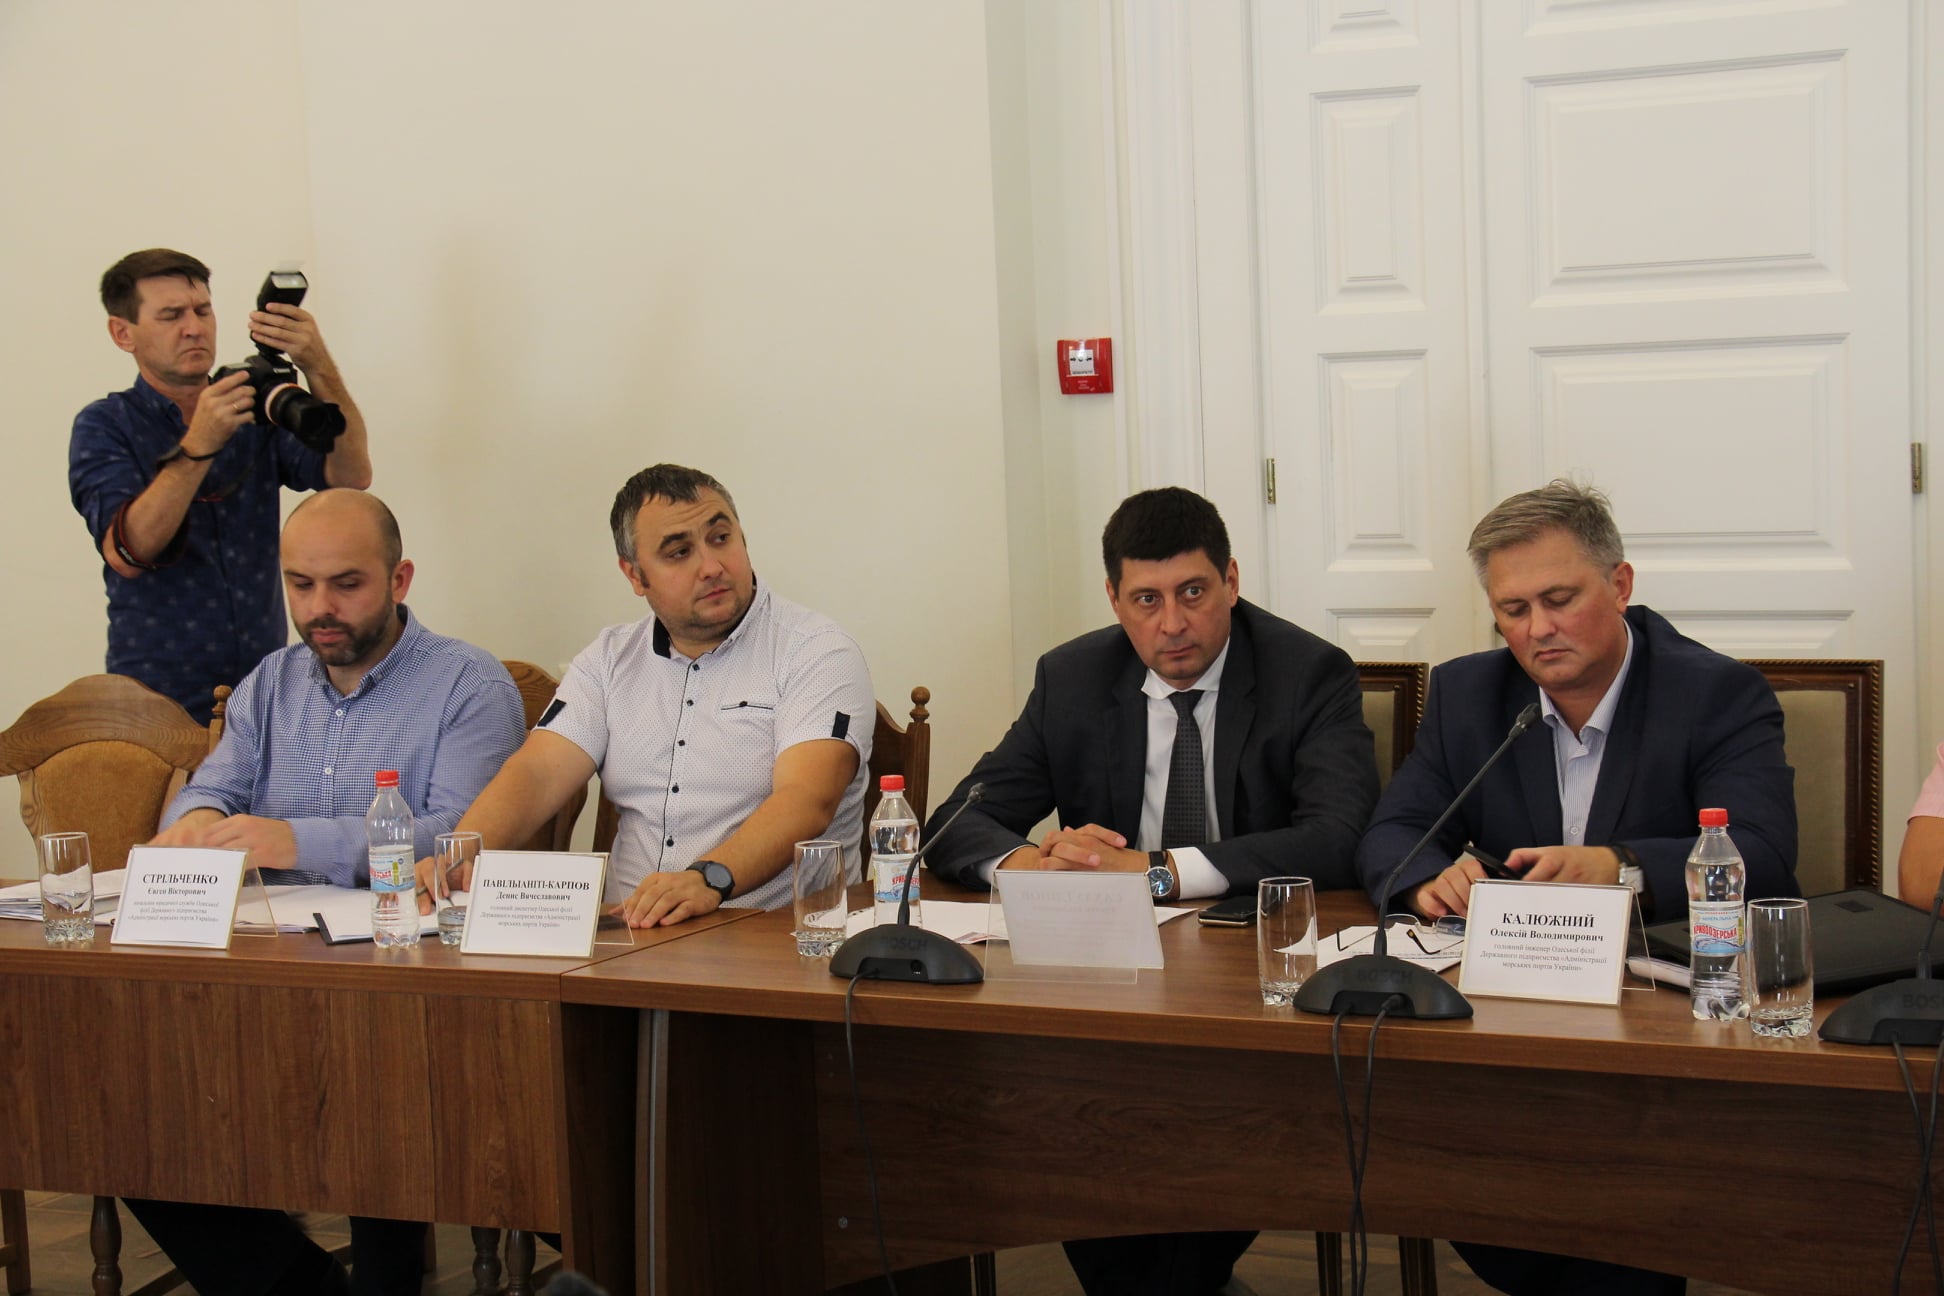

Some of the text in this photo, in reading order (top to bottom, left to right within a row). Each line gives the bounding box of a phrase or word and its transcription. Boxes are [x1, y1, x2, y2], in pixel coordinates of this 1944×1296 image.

[143, 873, 218, 885] СТРІЛЬЧЕНКО
[1502, 912, 1595, 928] КАЛЮЖНИЙ
[1490, 927, 1604, 943] Олексій Володимирович
[1903, 993, 1944, 1009] BOS
